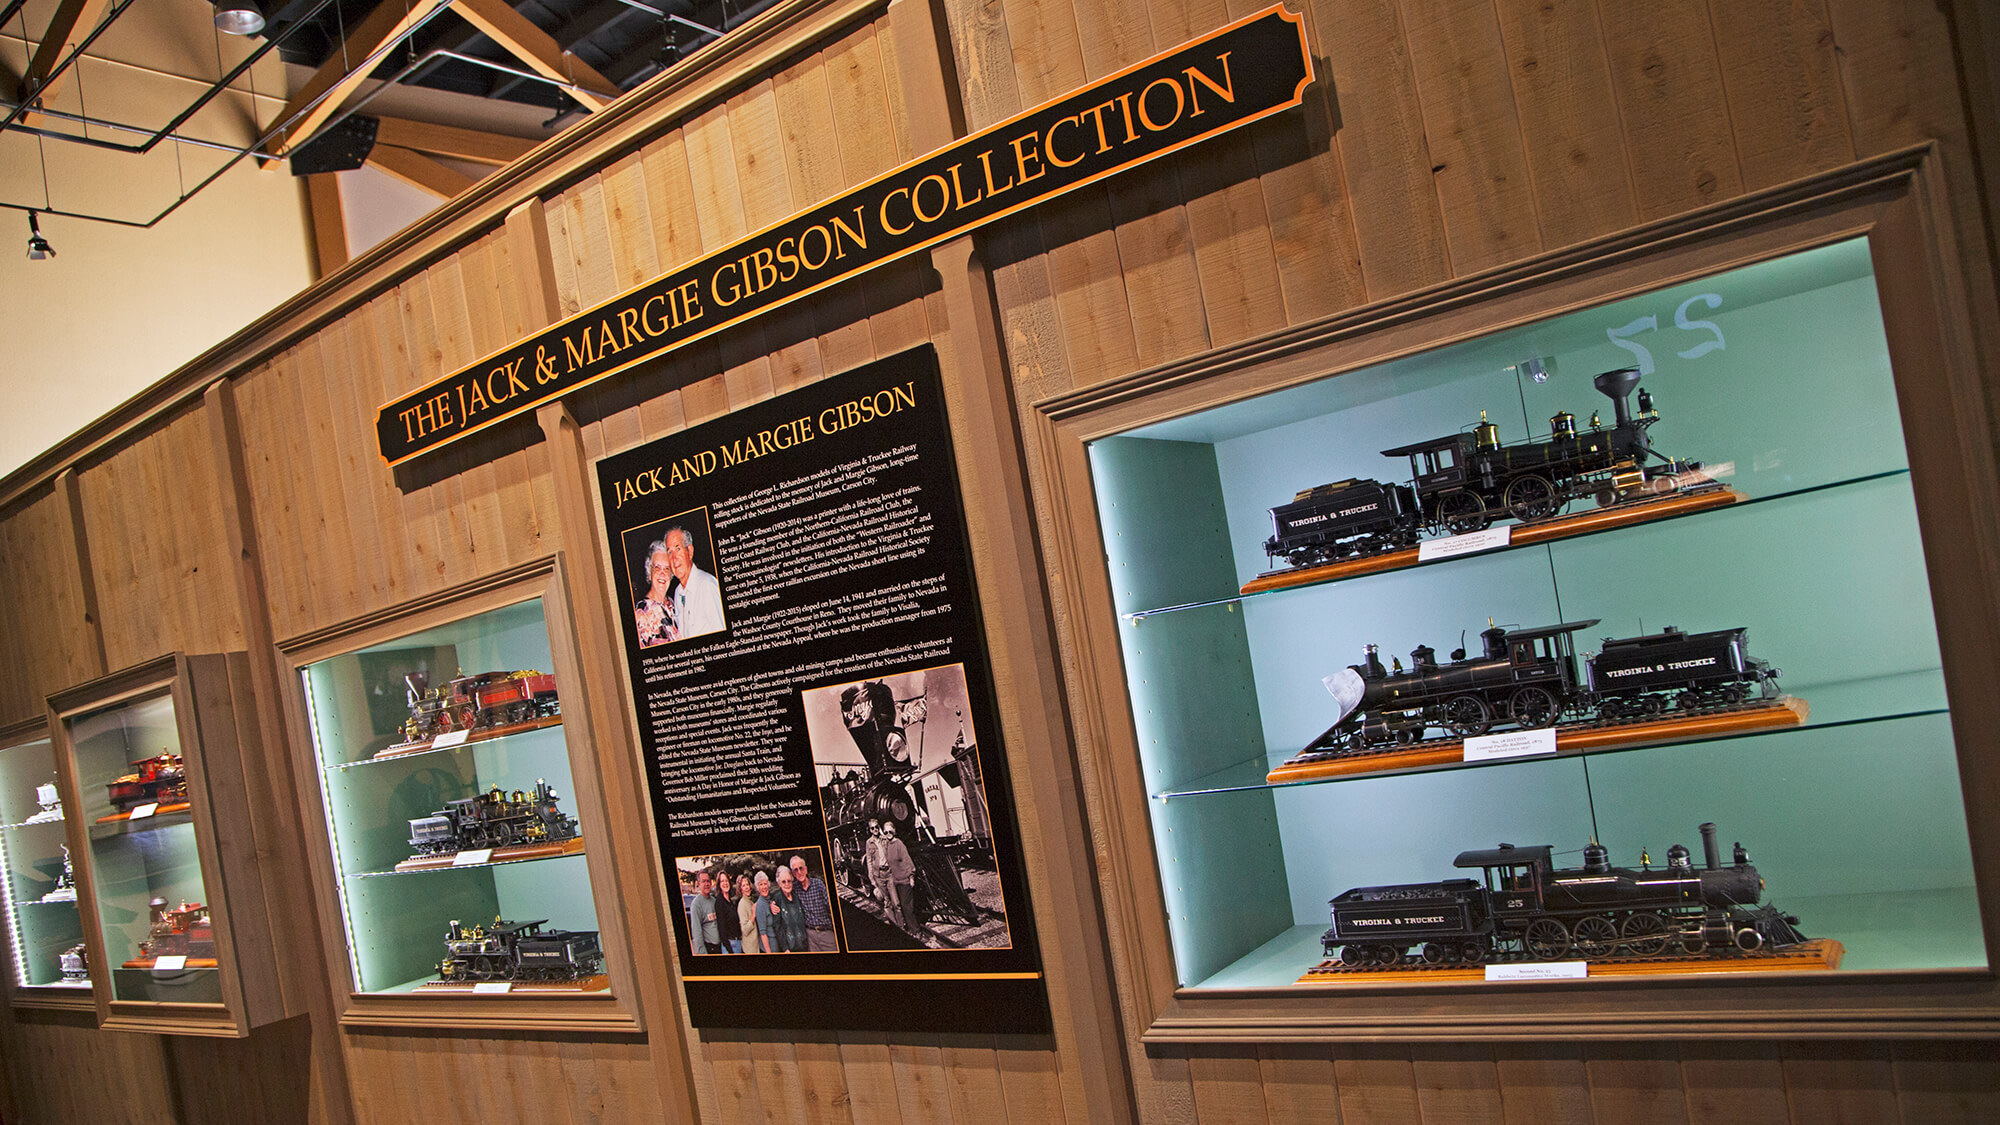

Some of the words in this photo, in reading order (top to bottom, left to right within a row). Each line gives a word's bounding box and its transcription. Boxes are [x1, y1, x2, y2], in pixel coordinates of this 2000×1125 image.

[399, 392, 453, 442] THE
[456, 357, 530, 428] JACK
[535, 345, 559, 384] &
[562, 279, 703, 373] MARGIE
[711, 205, 867, 306] GIBSON
[880, 51, 1234, 235] COLLECTION
[614, 467, 665, 509] JACK
[669, 451, 716, 486] AND
[721, 416, 814, 468] MARGIE
[819, 381, 915, 434] GIBSON
[712, 501, 723, 509] This
[723, 495, 747, 506] collection
[753, 487, 772, 497] George
[779, 476, 809, 489] Richardson
[809, 468, 830, 480] models
[830, 465, 837, 474] of
[837, 459, 861, 471] Virginia
[868, 451, 891, 462] Truckee
[891, 443, 916, 455] Railway
[713, 509, 730, 519] rolling
[730, 504, 743, 513] stock
[749, 494, 774, 508] dedicated
[790, 484, 813, 496] memory
[813, 480, 820, 489] of
[820, 477, 832, 488] Jack
[833, 473, 844, 483] and
[844, 468, 865, 480] Margie
[889, 453, 918, 467] long-time
[715, 516, 741, 528] supporters
[741, 512, 747, 520] of
[756, 504, 777, 515] Nevada
[777, 501, 791, 509] State
[791, 492, 814, 505] Railroad
[841, 480, 862, 491] Carson
[717, 538, 730, 547] John
[752, 526, 772, 536] Gibson
[802, 514, 813, 522] was
[817, 508, 837, 520] printer
[837, 503, 851, 512] with
[856, 496, 881, 507] life-long
[881, 492, 894, 500] love
[894, 488, 901, 497] of
[719, 547, 727, 555] He
[742, 538, 766, 549] founding
[766, 531, 787, 542] member
[788, 528, 794, 536] of
[804, 511, 859, 532] Northern-California
[859, 504, 884, 517] Railroad
[901, 497, 912, 505] the
[720, 553, 739, 563] Central
[739, 550, 754, 558] Coast
[754, 545, 775, 555] Railway
[791, 536, 802, 545] and
[802, 534, 811, 542] the
[811, 520, 863, 539] California-Nevada
[863, 513, 888, 526] Railroad
[888, 505, 918, 519] Historical
[741, 560, 750, 568] He
[761, 550, 784, 563] involved
[790, 547, 800, 555] the
[800, 542, 825, 553] initiation
[825, 538, 832, 546] of
[831, 535, 845, 544] both
[845, 533, 855, 541] the
[919, 512, 931, 522] and
[1289, 514, 1328, 528] VIRGINIA
[1339, 503, 1378, 517] TRUCKEE
[730, 619, 742, 629] Jack
[742, 616, 752, 625] and
[752, 613, 771, 623] Margie
[801, 601, 820, 612] eloped
[828, 598, 841, 607] June
[865, 588, 876, 597] and
[877, 583, 901, 595] married
[910, 579, 920, 587] the
[921, 576, 937, 585] steps
[938, 573, 945, 581] of
[1606, 666, 1654, 678] VIRGINIA
[1656, 664, 1665, 672] &
[1668, 657, 1716, 670] TRUCKEE
[1671, 857, 1688, 867] 25
[1404, 916, 1445, 924] TRUCKEE
[1507, 900, 1524, 908] 25
